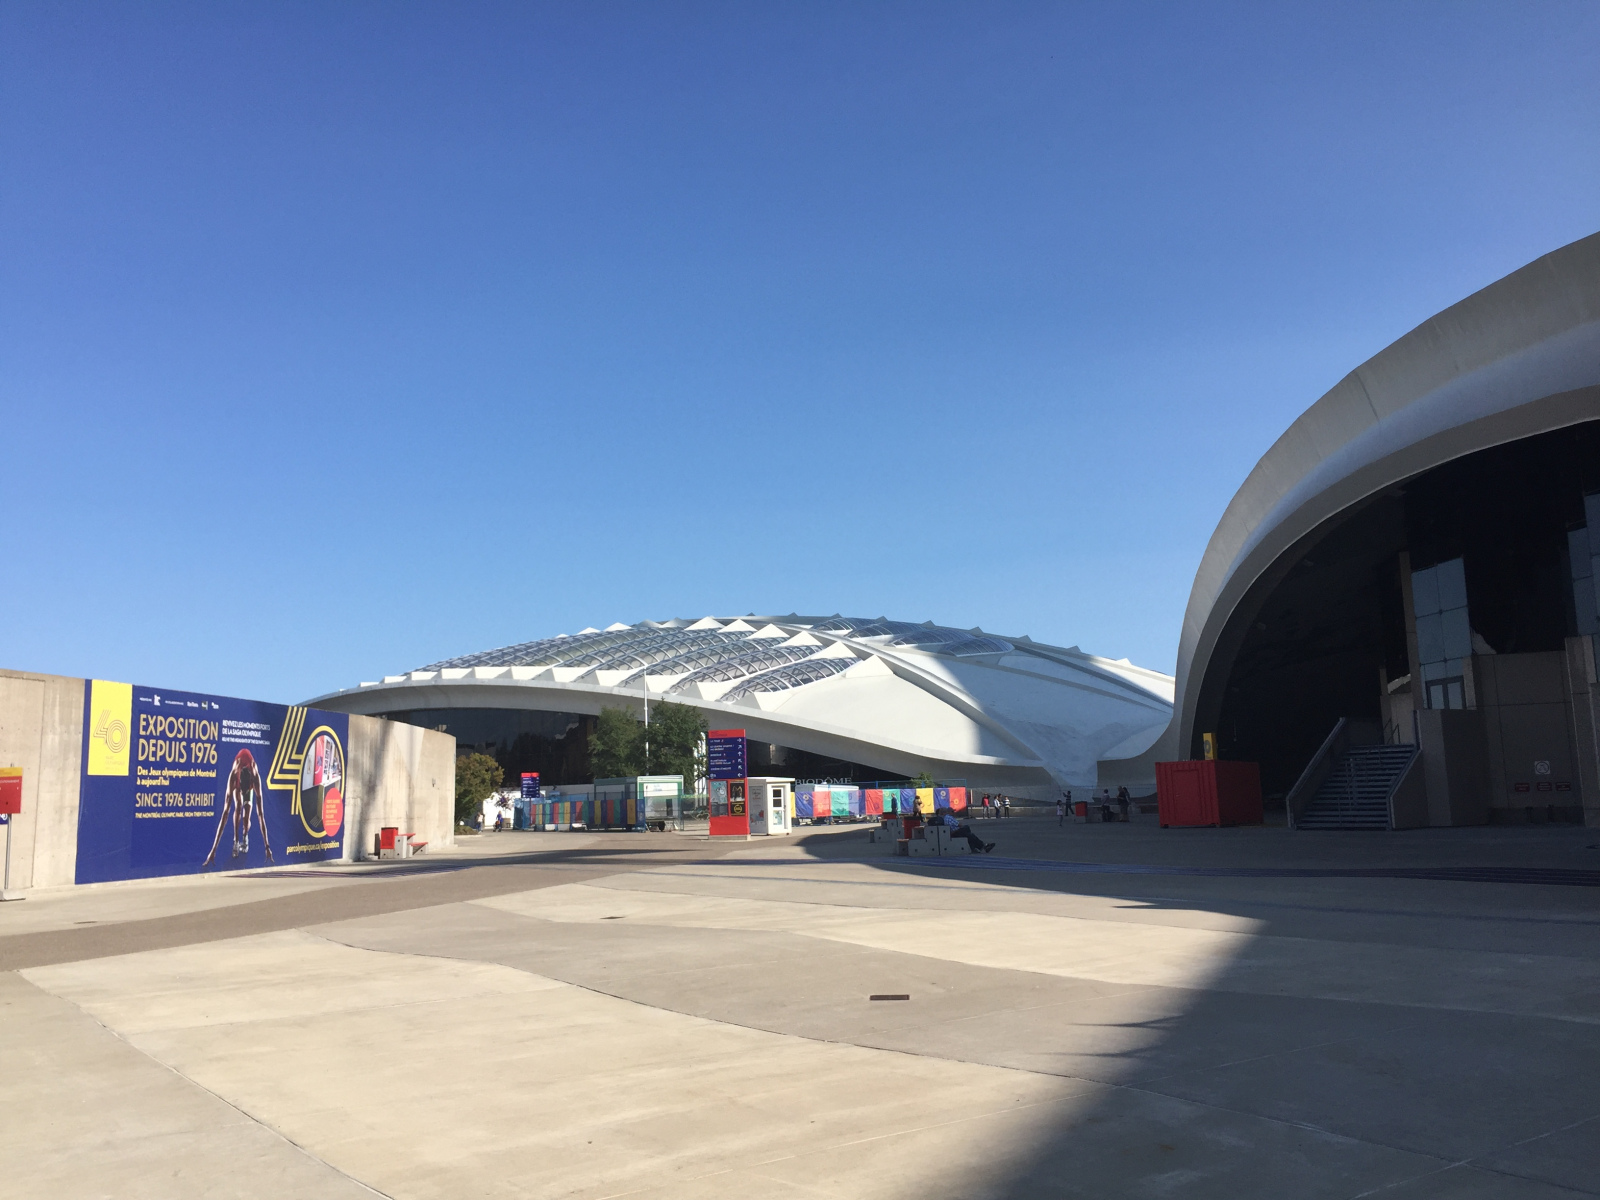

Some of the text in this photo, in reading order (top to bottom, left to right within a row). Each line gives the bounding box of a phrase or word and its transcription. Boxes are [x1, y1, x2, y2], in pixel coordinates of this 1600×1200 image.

[139, 713, 219, 741] EXPOSITION
[138, 738, 187, 763] DEPUIS
[190, 742, 218, 765] 1976
[137, 765, 217, 778] Des Jeux olympiques de Montréal
[795, 777, 852, 786] BIODÔME
[135, 792, 215, 808] SINCE 1976 EXHIBIT
